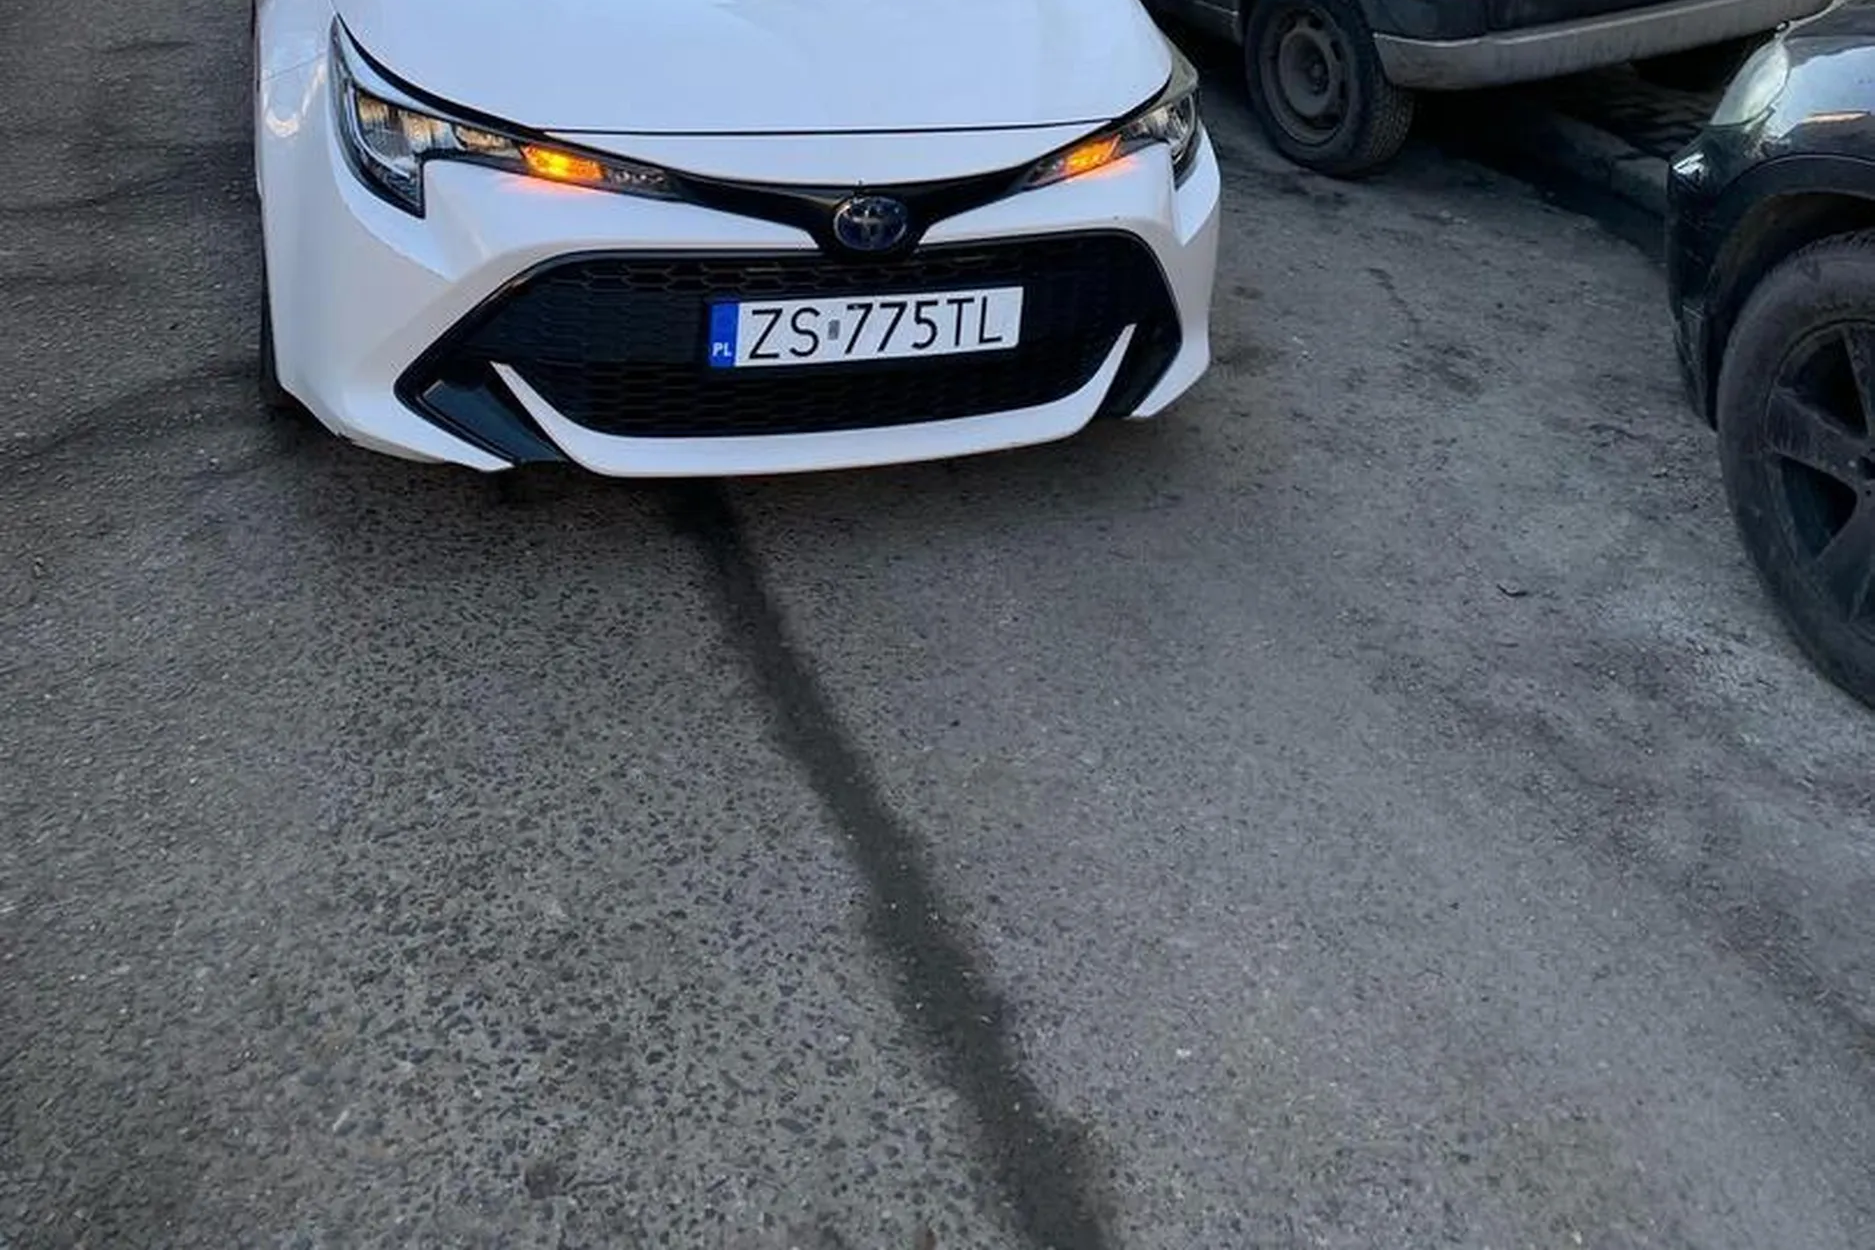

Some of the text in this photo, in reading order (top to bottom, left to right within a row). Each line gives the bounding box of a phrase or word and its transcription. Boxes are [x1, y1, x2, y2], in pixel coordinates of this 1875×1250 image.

[750, 296, 1003, 358] ZS 775TL
[712, 342, 732, 358] PL
